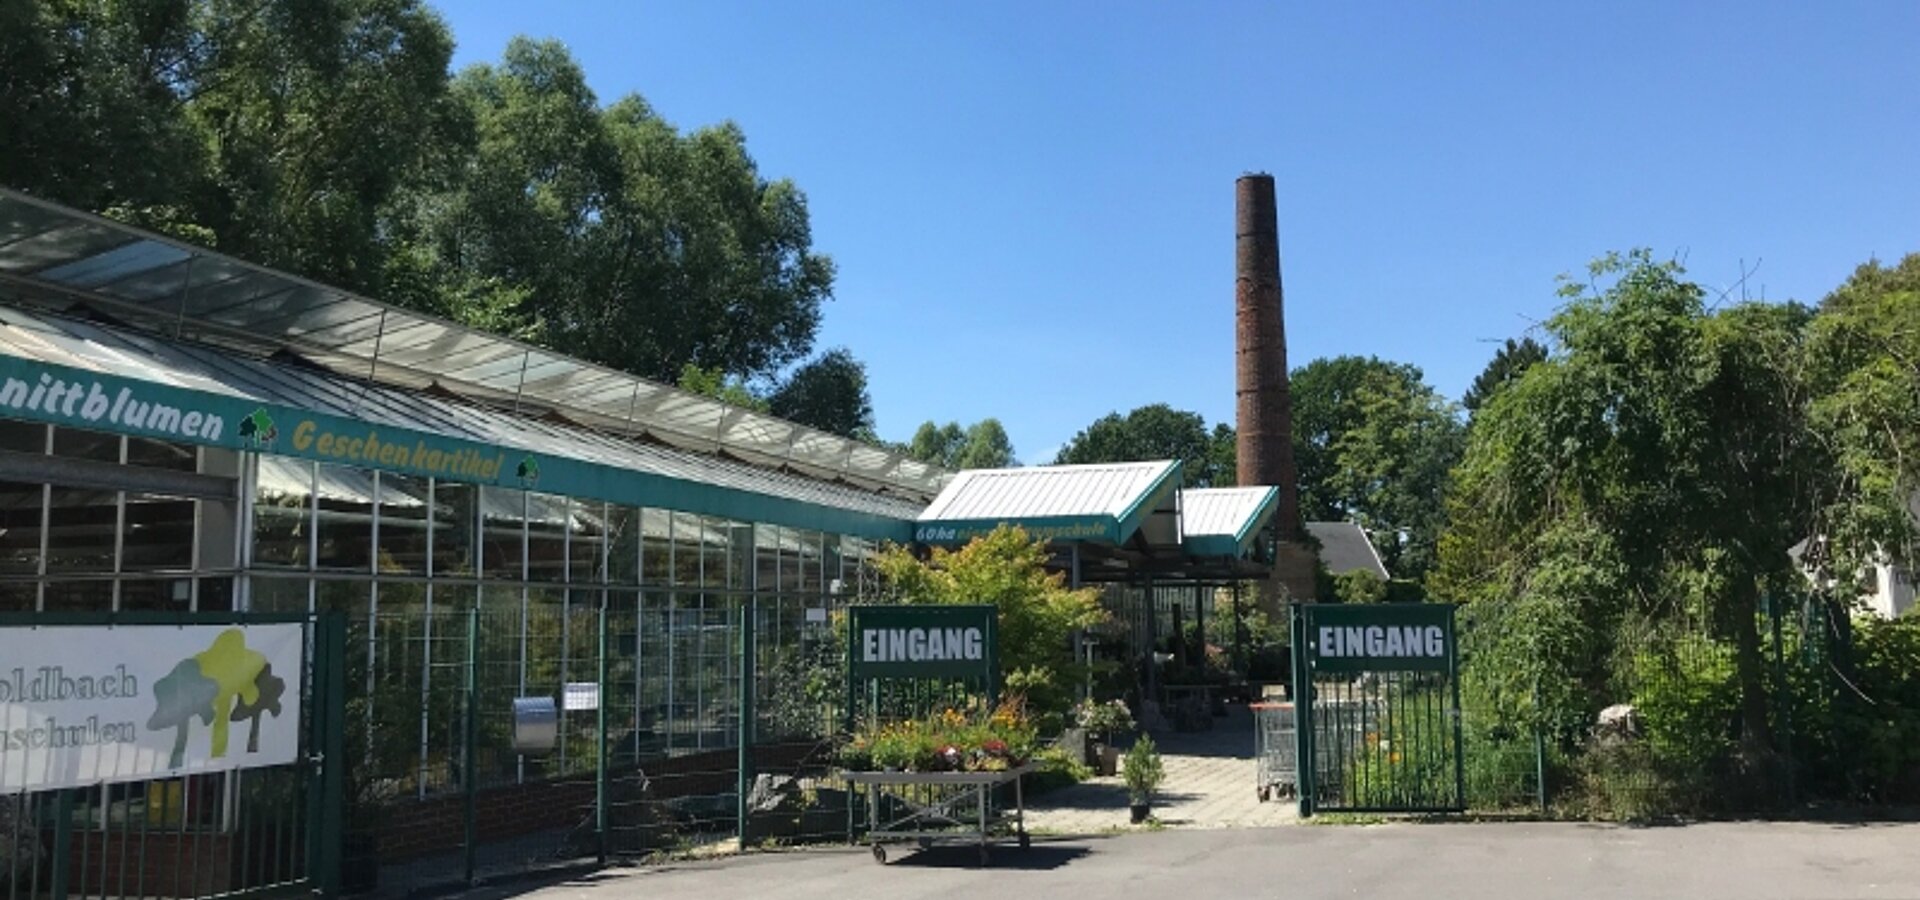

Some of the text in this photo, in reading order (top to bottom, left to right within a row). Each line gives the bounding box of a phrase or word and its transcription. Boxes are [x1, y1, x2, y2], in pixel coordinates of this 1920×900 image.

[0, 372, 225, 442] nittblumen
[291, 420, 505, 479] Geschenkartikel
[863, 628, 983, 662] EINGANG
[1319, 626, 1444, 657] EINGANG
